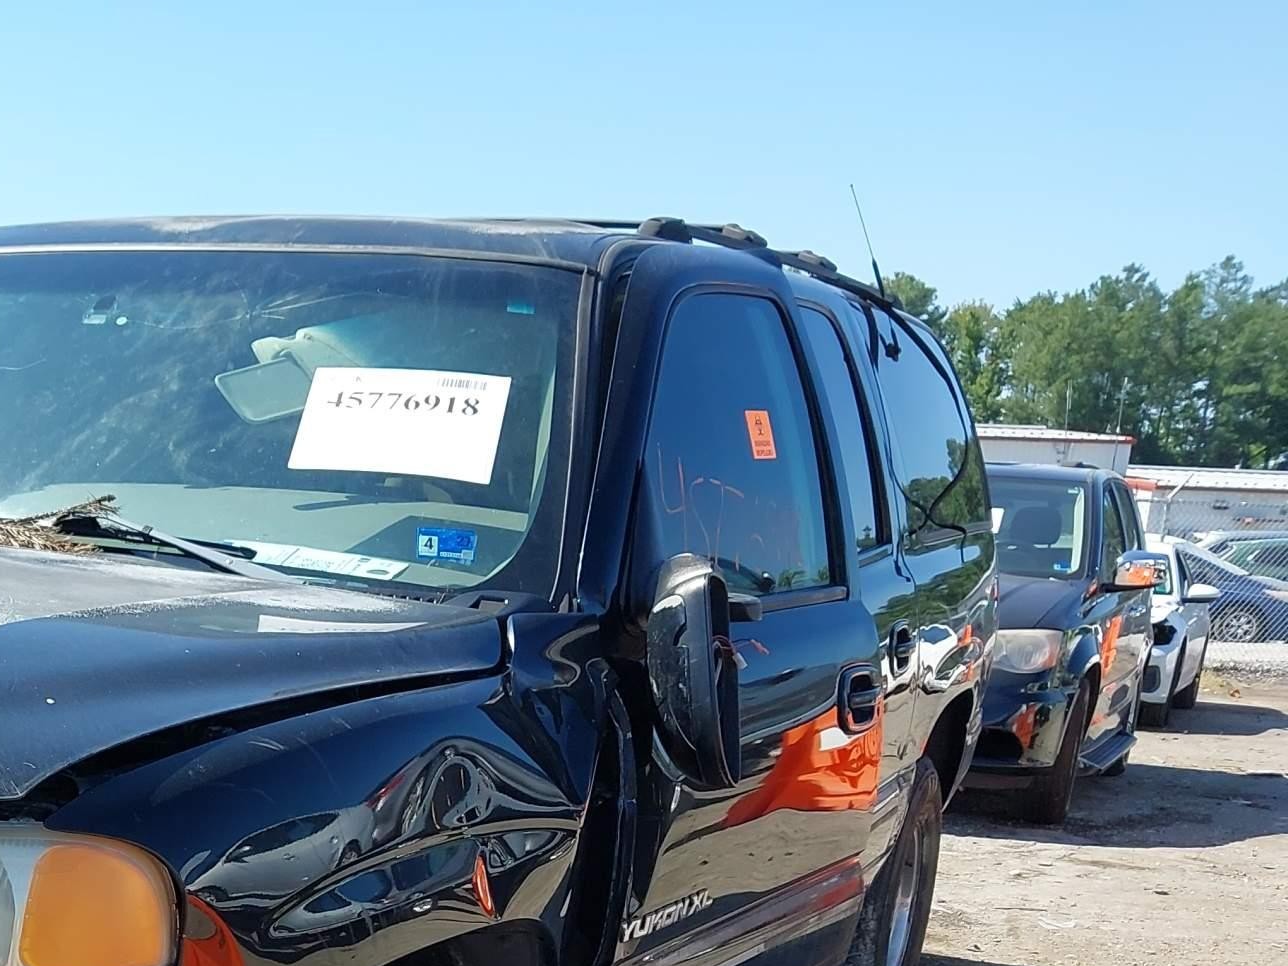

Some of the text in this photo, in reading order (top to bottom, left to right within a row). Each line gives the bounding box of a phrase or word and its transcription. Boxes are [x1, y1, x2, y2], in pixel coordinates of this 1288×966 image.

[327, 391, 480, 416] 45776918
[424, 537, 434, 550] 4
[687, 890, 714, 917] XL
